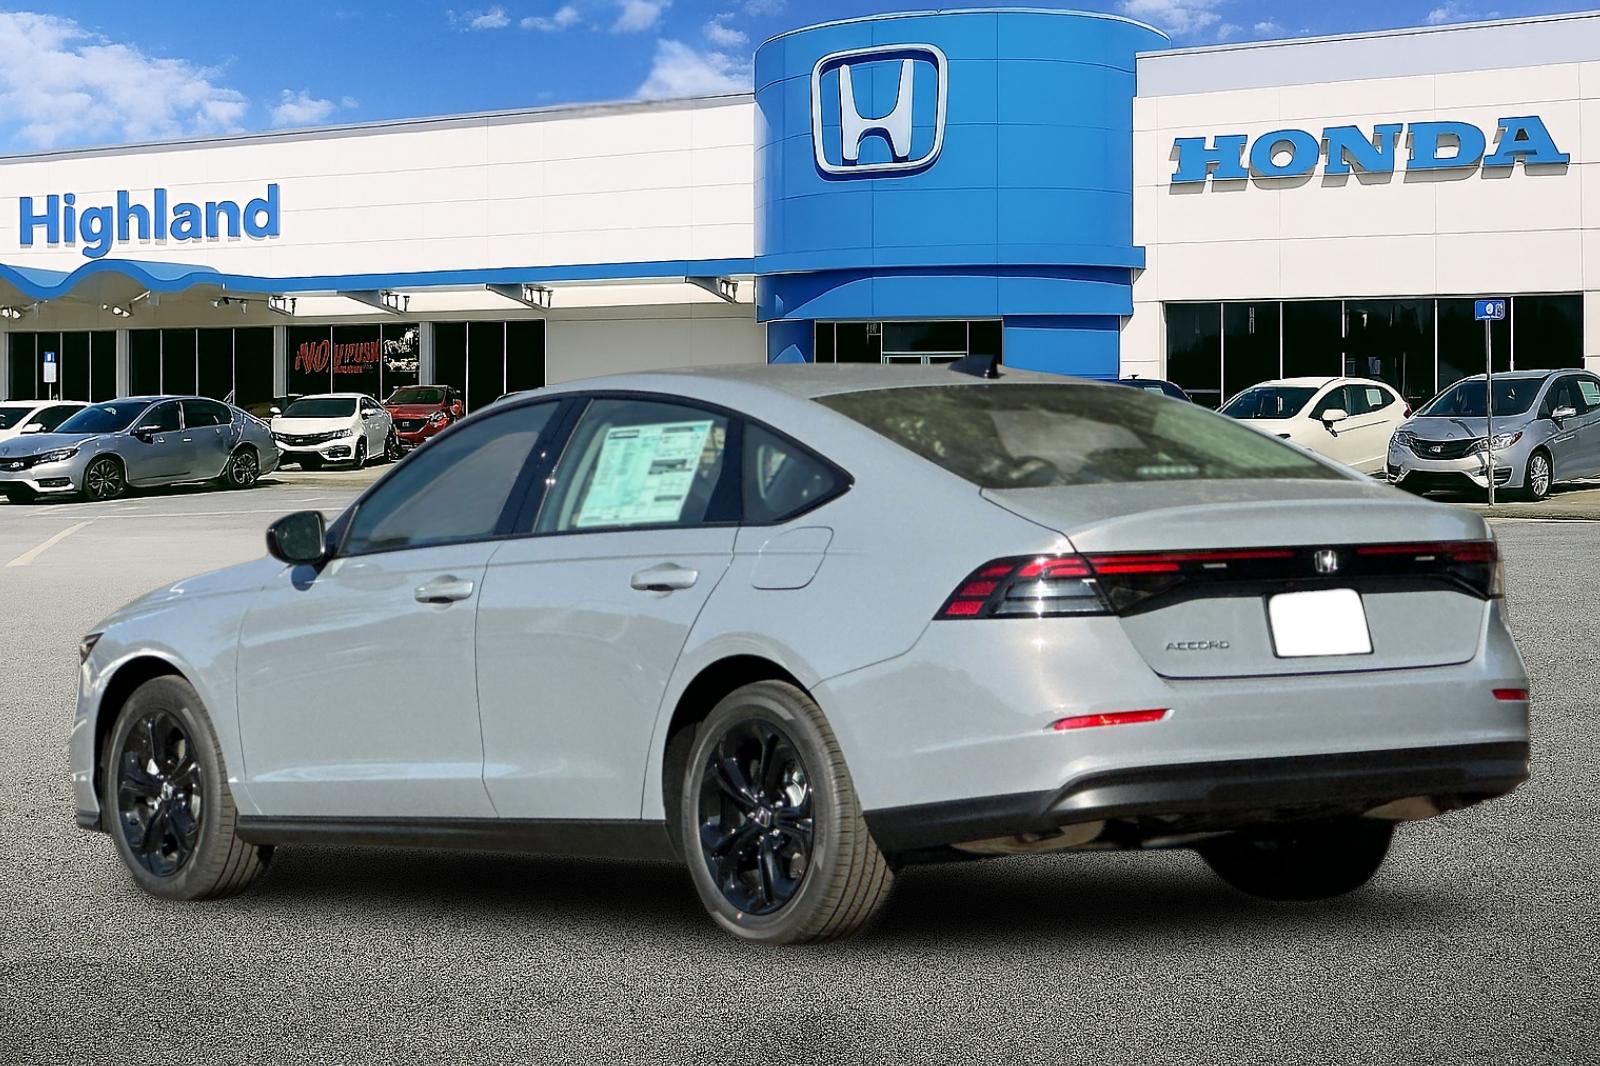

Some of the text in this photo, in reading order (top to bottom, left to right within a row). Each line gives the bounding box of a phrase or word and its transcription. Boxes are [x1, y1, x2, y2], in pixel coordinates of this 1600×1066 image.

[1171, 115, 1570, 184] HONDA
[20, 183, 280, 257] Highland
[1165, 640, 1230, 651] ACCORD
